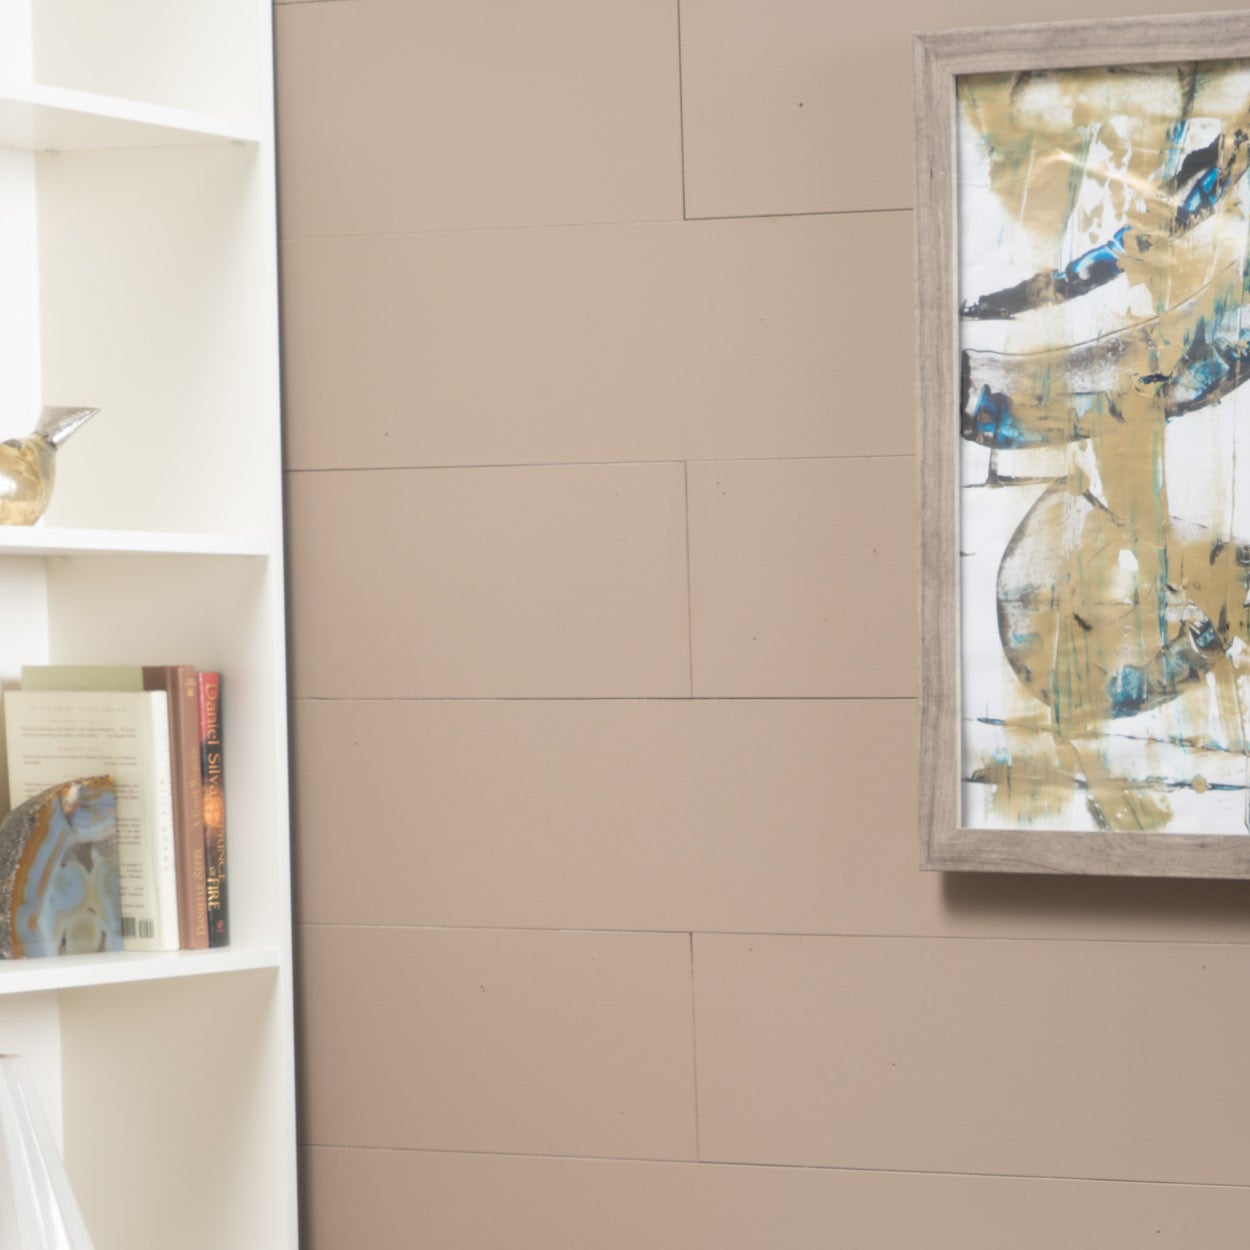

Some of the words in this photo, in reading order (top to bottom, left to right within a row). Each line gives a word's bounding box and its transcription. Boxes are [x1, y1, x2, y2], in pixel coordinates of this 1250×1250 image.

[205, 683, 220, 745] Daniel
[208, 752, 220, 796] Silva
[207, 878, 219, 911] FIRE
